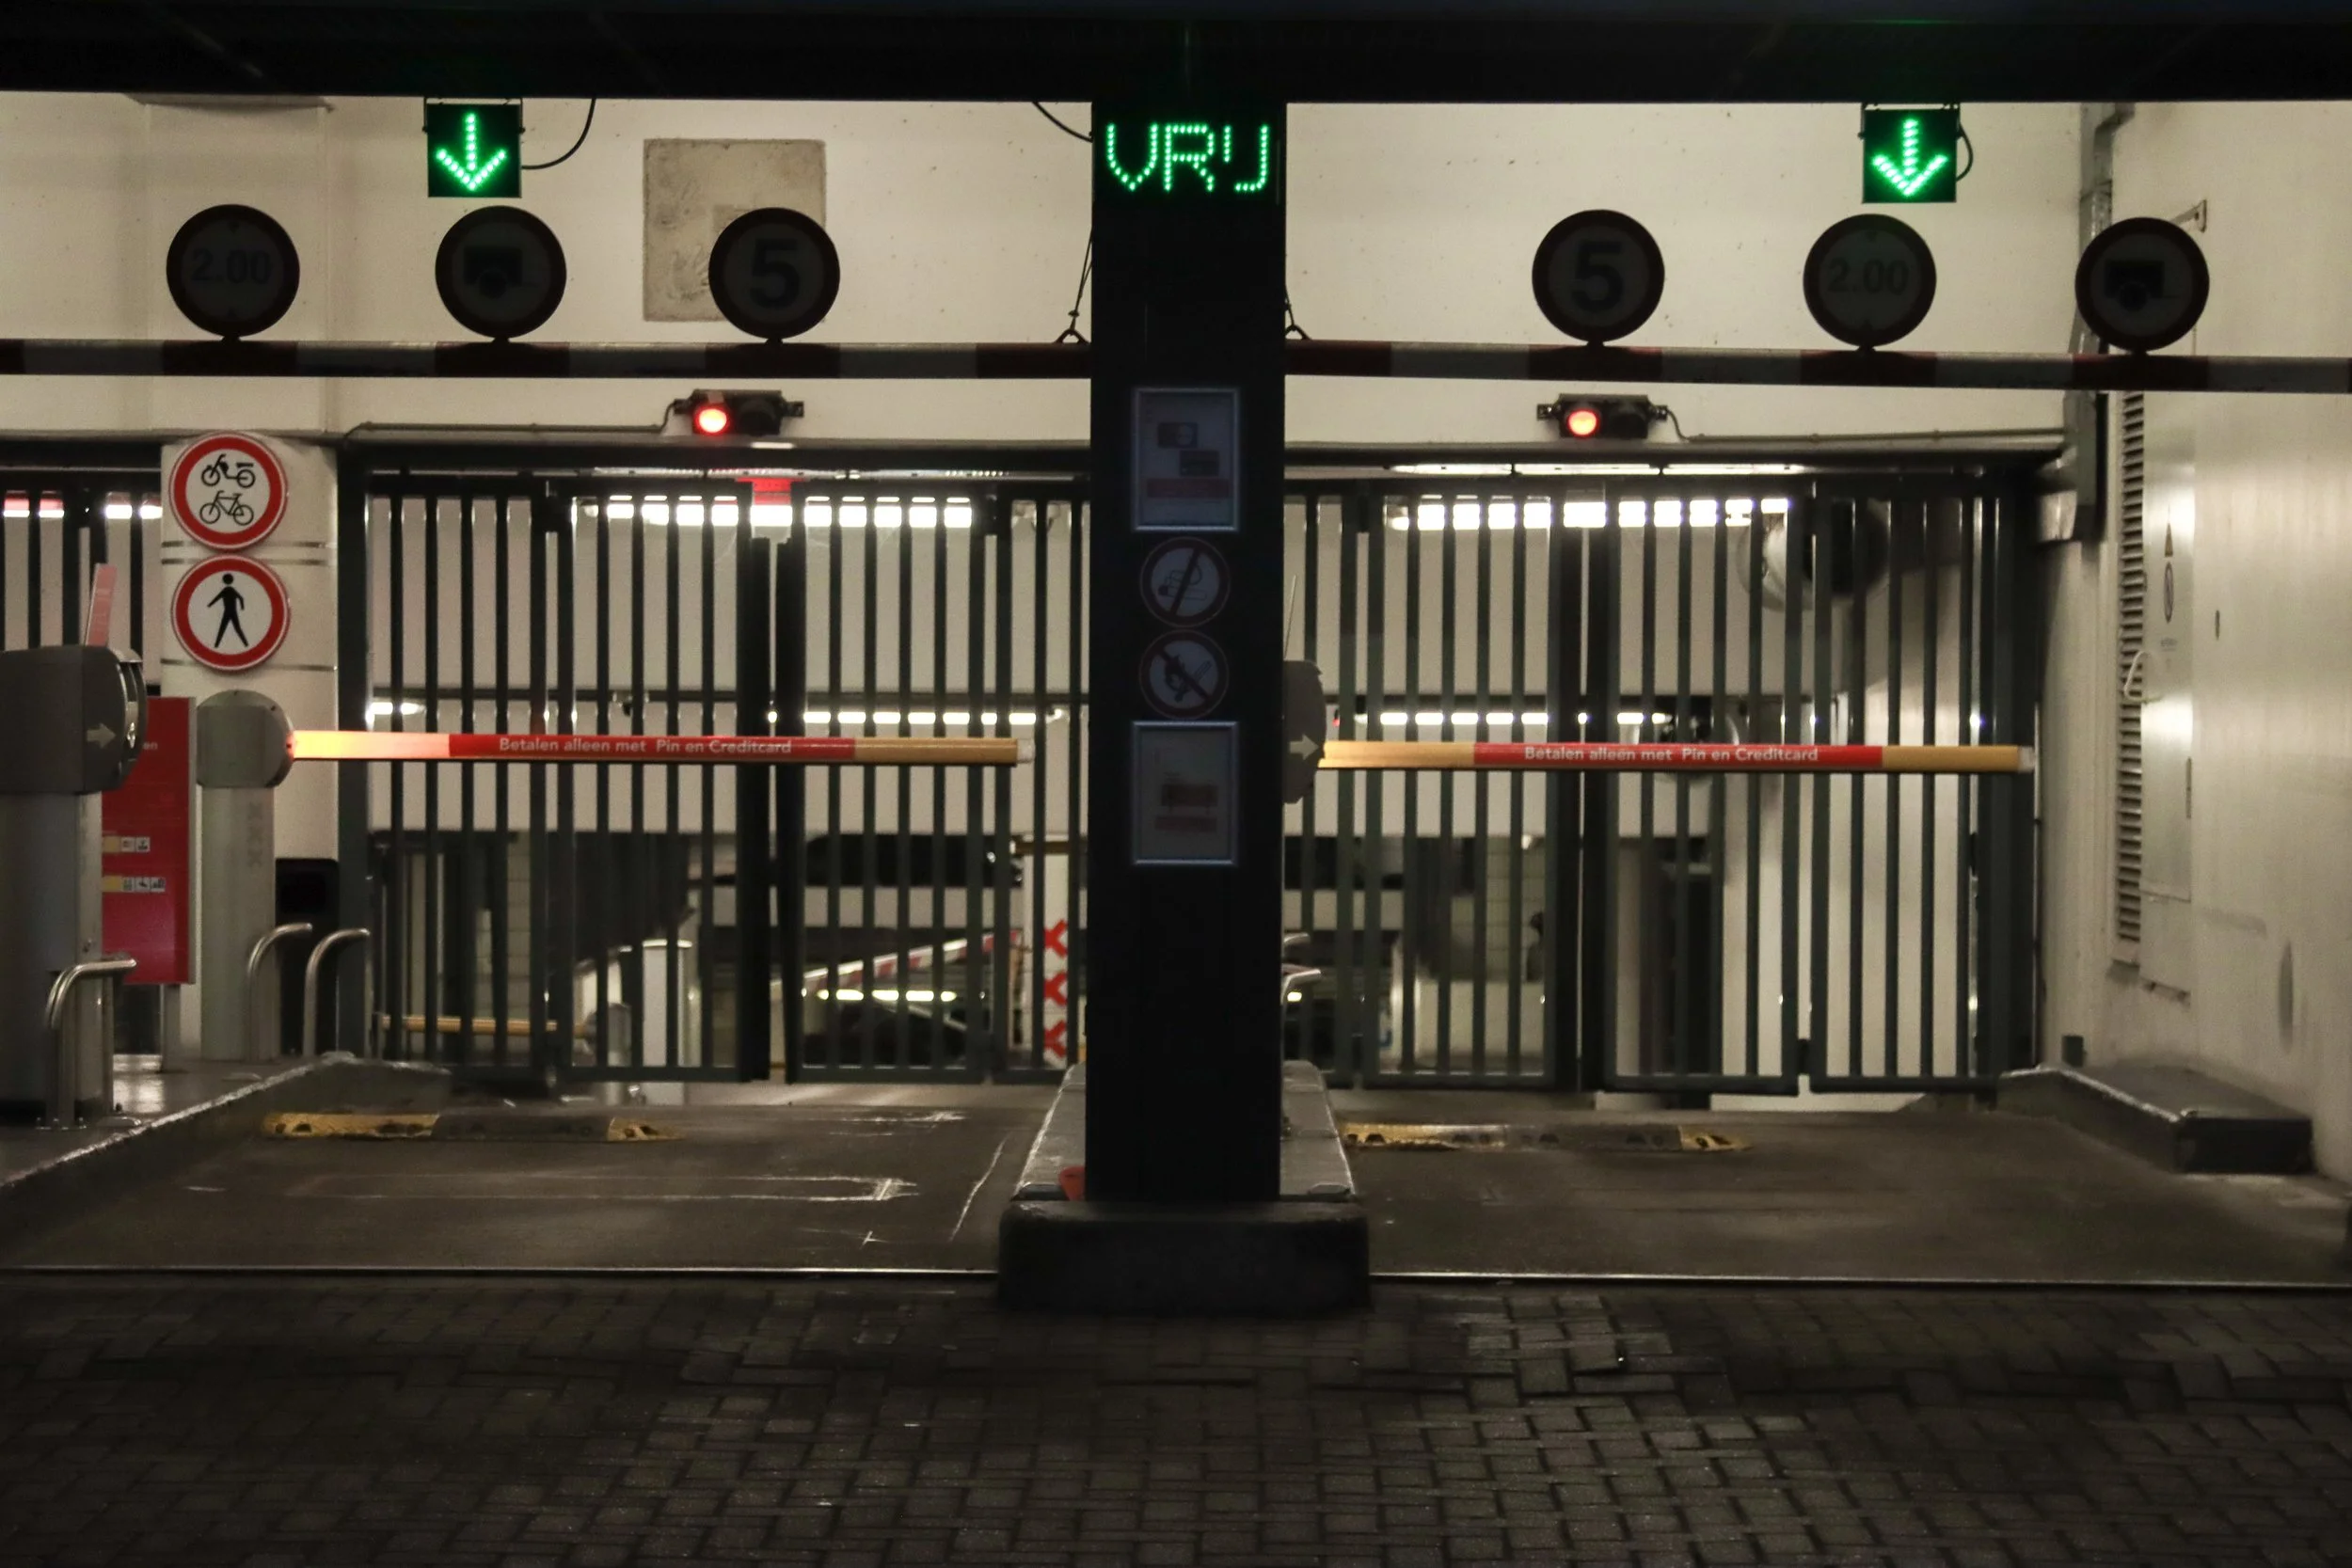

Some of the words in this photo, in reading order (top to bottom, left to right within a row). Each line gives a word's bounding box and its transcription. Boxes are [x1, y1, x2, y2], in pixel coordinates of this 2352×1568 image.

[191, 246, 272, 284] 2.00
[750, 238, 800, 309] 5
[1571, 240, 1623, 313] 5
[1826, 257, 1909, 295] 2.00
[499, 736, 559, 752] Betalen
[564, 737, 611, 752] alleen
[615, 740, 647, 752] met
[657, 739, 679, 752] Pin
[685, 742, 704, 752] en
[708, 739, 792, 753] Creditcard
[1524, 746, 1584, 761] Betalen
[1589, 747, 1636, 761] alleen
[1641, 750, 1673, 761] met
[1682, 748, 1706, 761] Pin
[1711, 751, 1730, 761] en
[1736, 748, 1819, 761] Creditcard
